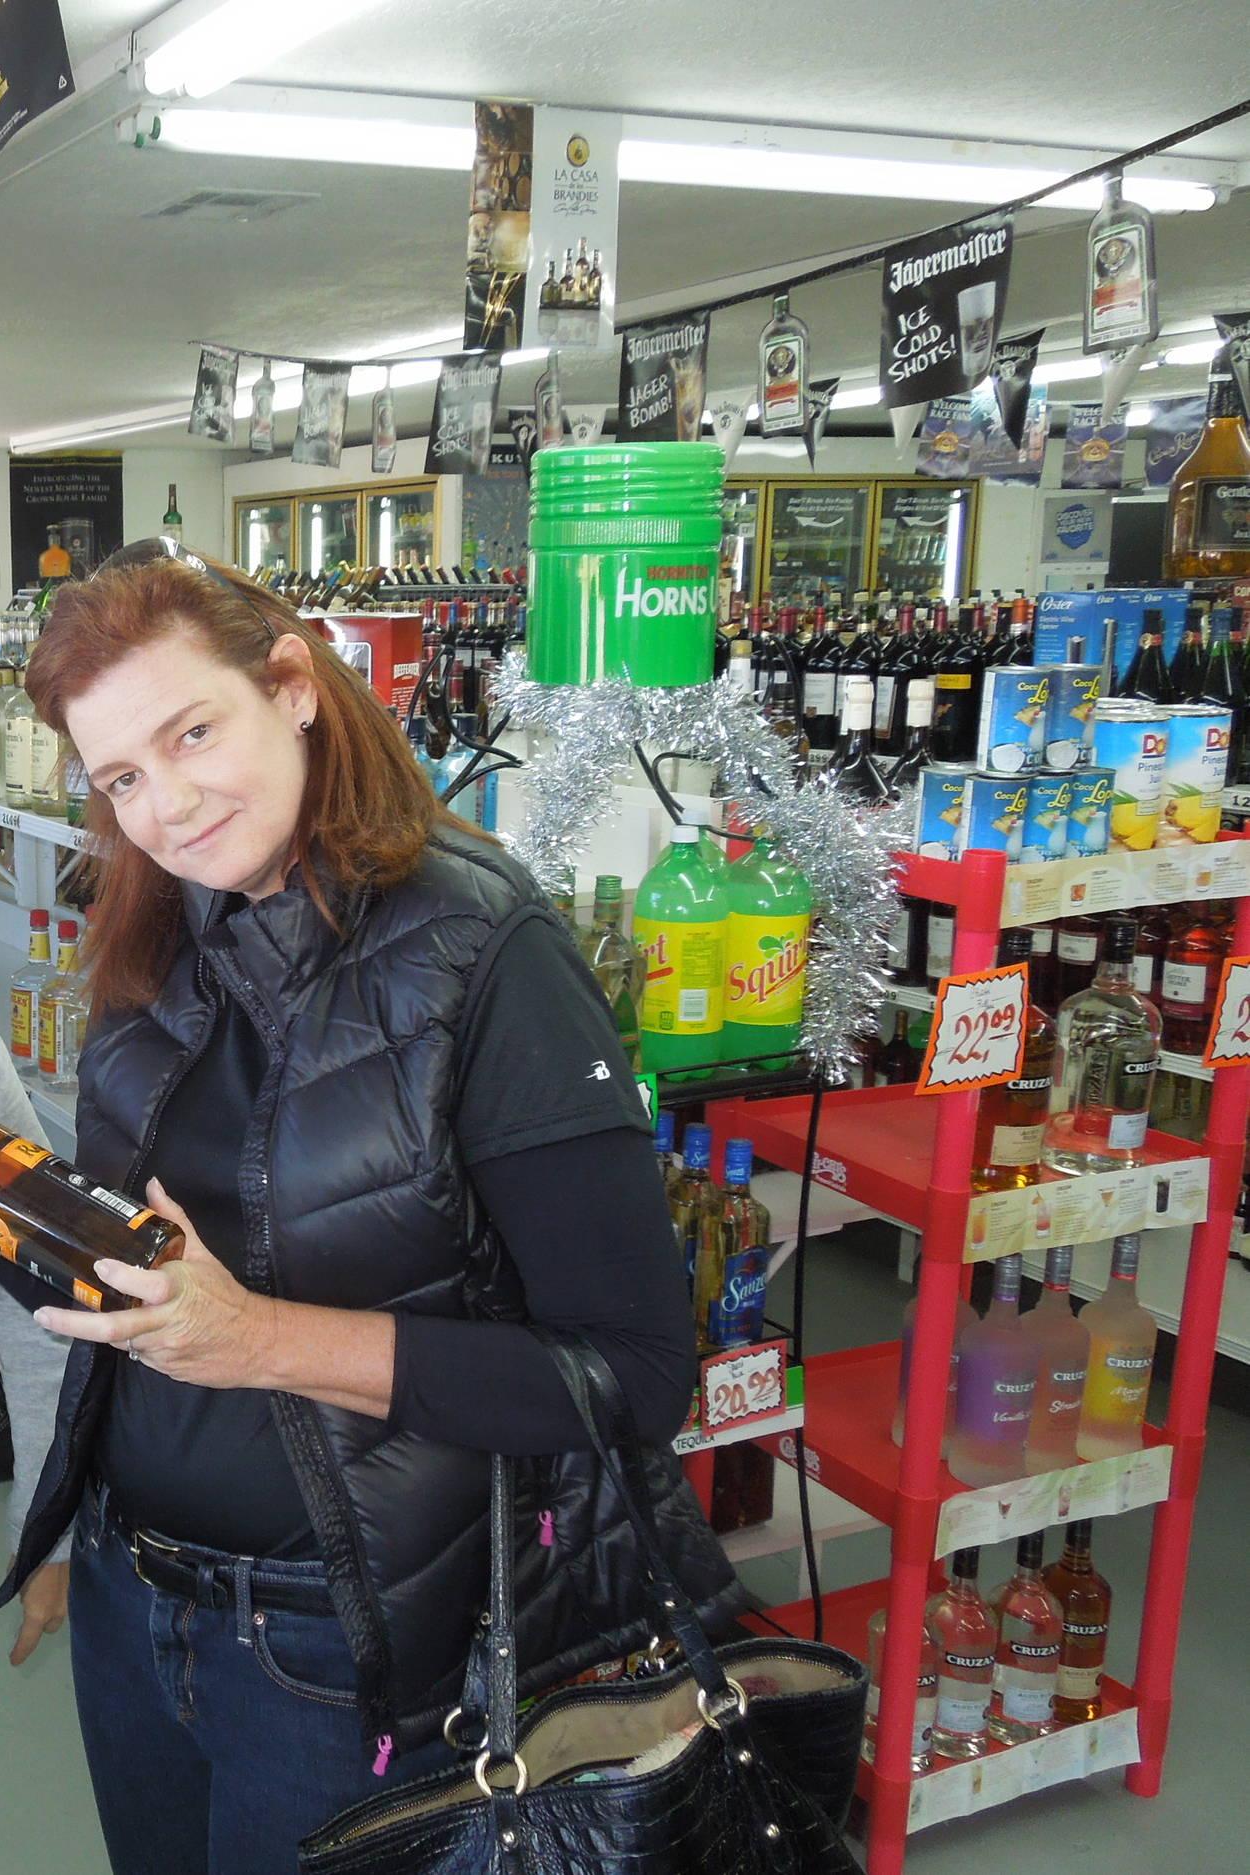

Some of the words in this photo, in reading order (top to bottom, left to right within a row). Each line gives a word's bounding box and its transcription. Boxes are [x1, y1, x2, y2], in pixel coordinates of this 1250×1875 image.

[554, 169, 567, 181] LA
[570, 170, 598, 182] CASA
[554, 190, 598, 201] BRANDIES
[898, 305, 931, 336] ICE
[893, 325, 942, 359] COLD
[888, 334, 957, 383] SHOTS!
[629, 391, 673, 428] BOMB!
[932, 401, 971, 409] WELCOM
[1075, 407, 1124, 416] WELCE
[615, 567, 707, 617] HORNS
[1040, 596, 1074, 612] Oster
[1007, 1078, 1053, 1091] CRUZA
[1053, 1370, 1088, 1381] CRUZ
[996, 1381, 1038, 1393] CRUZ
